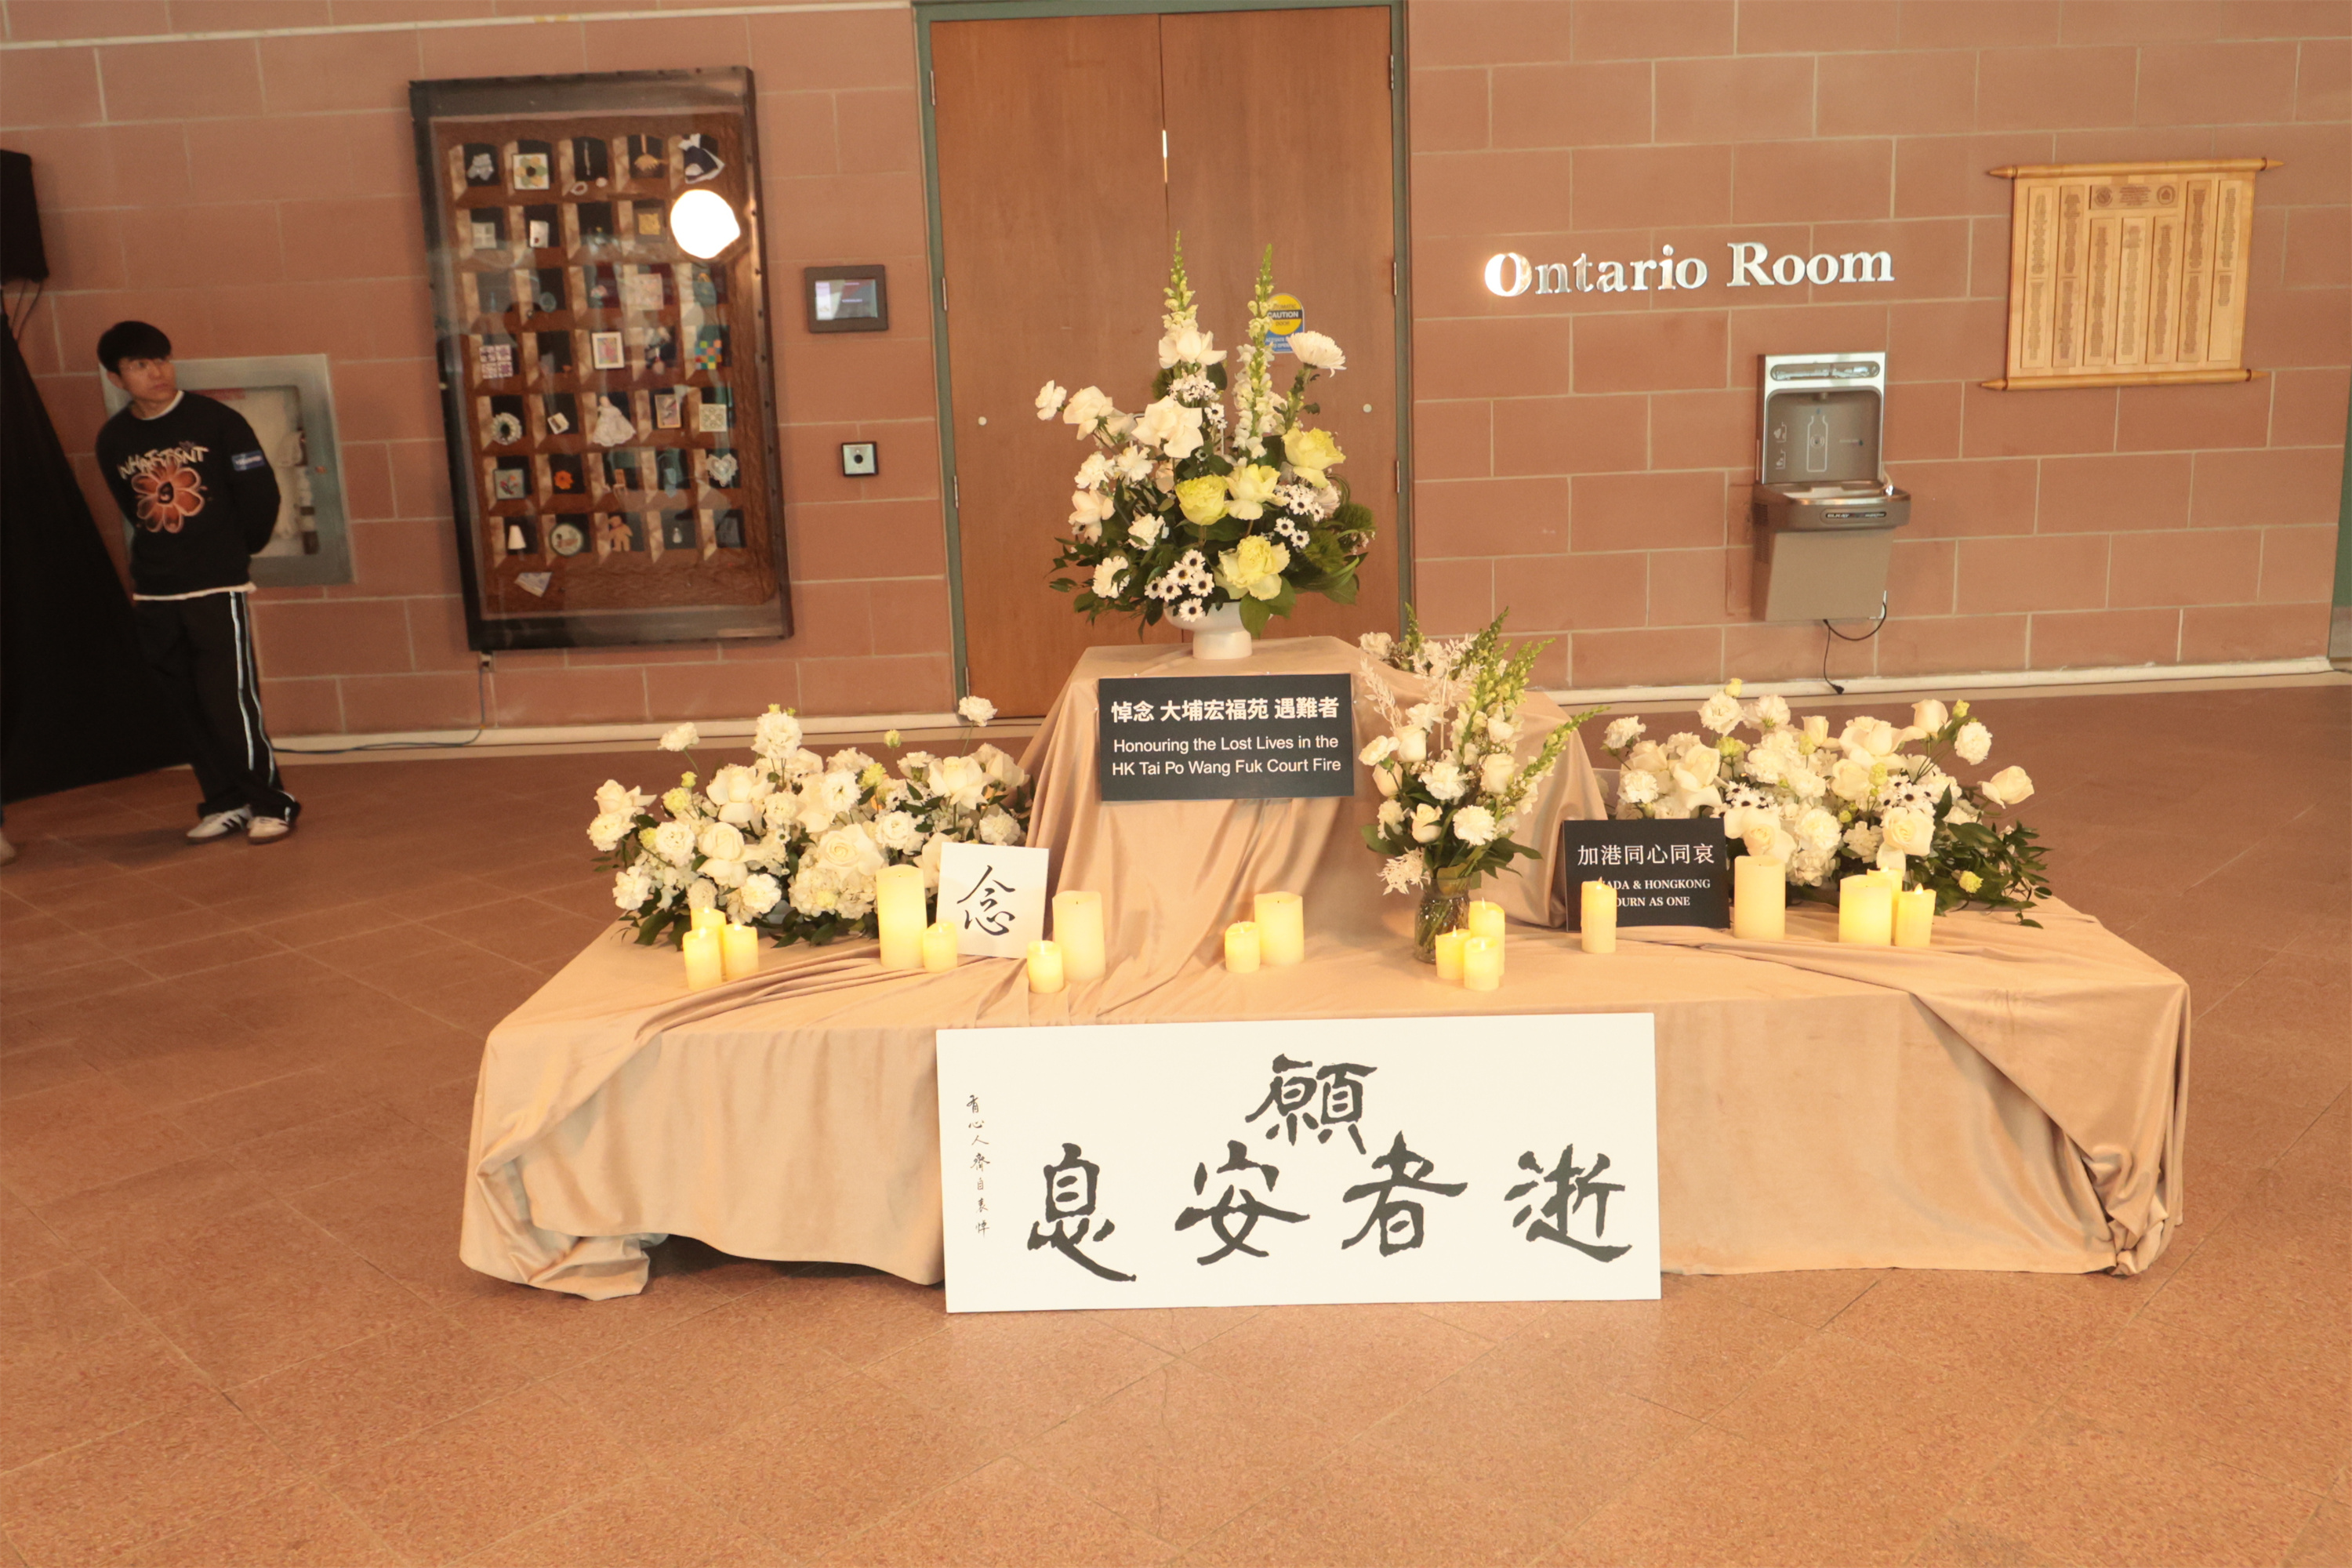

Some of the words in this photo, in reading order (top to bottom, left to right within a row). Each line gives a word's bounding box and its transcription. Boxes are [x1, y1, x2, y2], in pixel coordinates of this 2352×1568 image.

[1483, 244, 1708, 297] Ontario
[1726, 241, 1895, 288] Room
[1111, 701, 1154, 723] 悼念
[1160, 699, 1269, 722] 大埔宏福苑
[1275, 697, 1339, 720] 遇難者
[1114, 739, 1189, 754] Honouring
[1193, 738, 1216, 750] the
[1221, 737, 1252, 750] Lost
[1257, 736, 1294, 750] Lives
[1299, 735, 1310, 748] in
[1316, 735, 1339, 749] the
[1112, 762, 1135, 775] HK
[1139, 762, 1160, 775] Tai
[1166, 761, 1184, 774] Po
[1189, 761, 1231, 777] Wang
[1236, 760, 1263, 773] Fuk
[1267, 759, 1309, 772] Court
[1313, 758, 1341, 771] Fire
[1577, 843, 1715, 866] 加港同心同哀
[1633, 880, 1642, 889] &
[1645, 879, 1711, 889] HONGKONG
[956, 865, 1016, 936] 念
[1617, 897, 1646, 907] OURN
[1650, 898, 1664, 906] AS
[1667, 897, 1690, 906] ONE
[1244, 1053, 1377, 1155] 願
